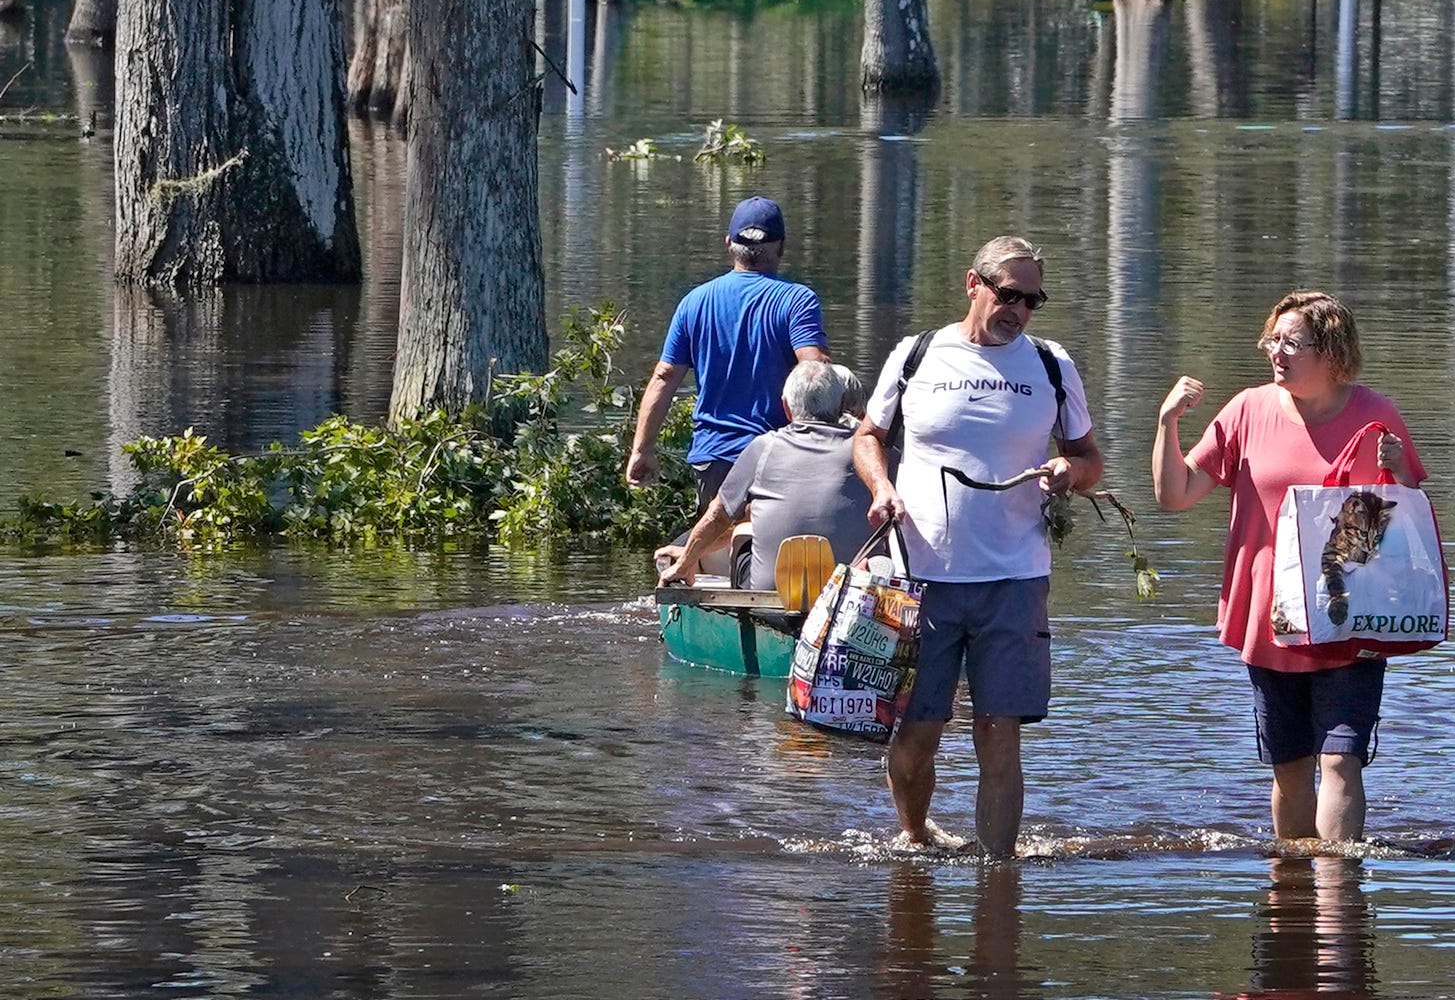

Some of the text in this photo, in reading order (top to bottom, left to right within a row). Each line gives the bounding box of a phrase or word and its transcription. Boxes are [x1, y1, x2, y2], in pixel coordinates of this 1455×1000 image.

[932, 379, 1033, 396] RUNNING
[1351, 614, 1445, 634] EXPLORE.
[847, 620, 888, 652] W2UHG
